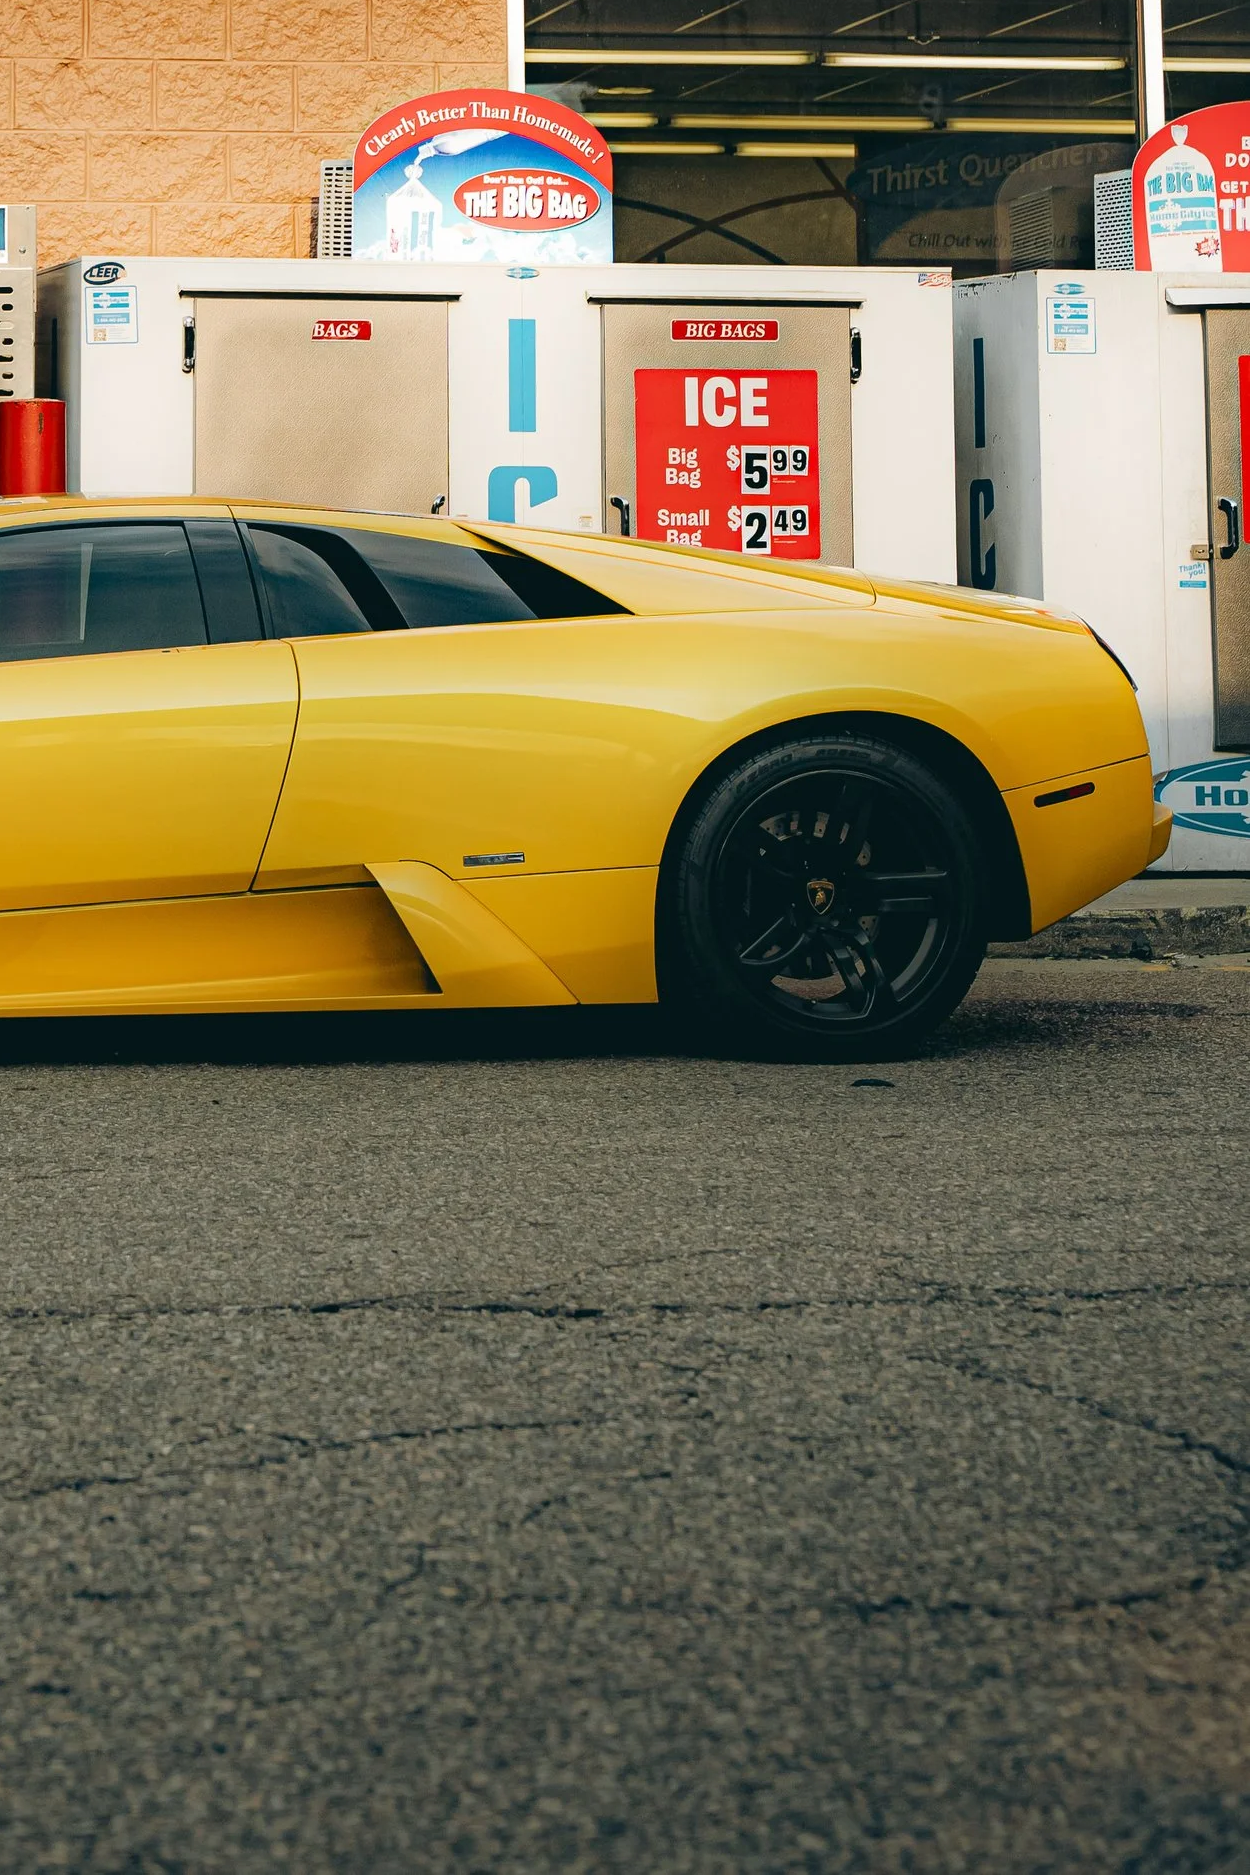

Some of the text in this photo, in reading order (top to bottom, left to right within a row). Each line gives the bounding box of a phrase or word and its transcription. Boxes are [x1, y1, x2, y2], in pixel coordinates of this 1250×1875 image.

[364, 116, 418, 156] Clearly
[416, 104, 467, 127] Better
[469, 101, 510, 121] Than
[867, 159, 948, 195] Thirst
[1165, 171, 1193, 194] BIG
[1220, 180, 1249, 194] GET
[463, 185, 588, 220] THE BIG BAG
[908, 233, 941, 248] Chill
[944, 233, 970, 248] Out
[89, 267, 119, 278] LEER
[312, 322, 359, 338] BAGS
[685, 322, 767, 339] BIG BAGS
[684, 376, 770, 428] ICE
[668, 447, 699, 469] Big
[665, 468, 702, 489] Bag
[657, 508, 710, 527] Small
[666, 529, 703, 548] Bag
[1179, 561, 1203, 573] Thank
